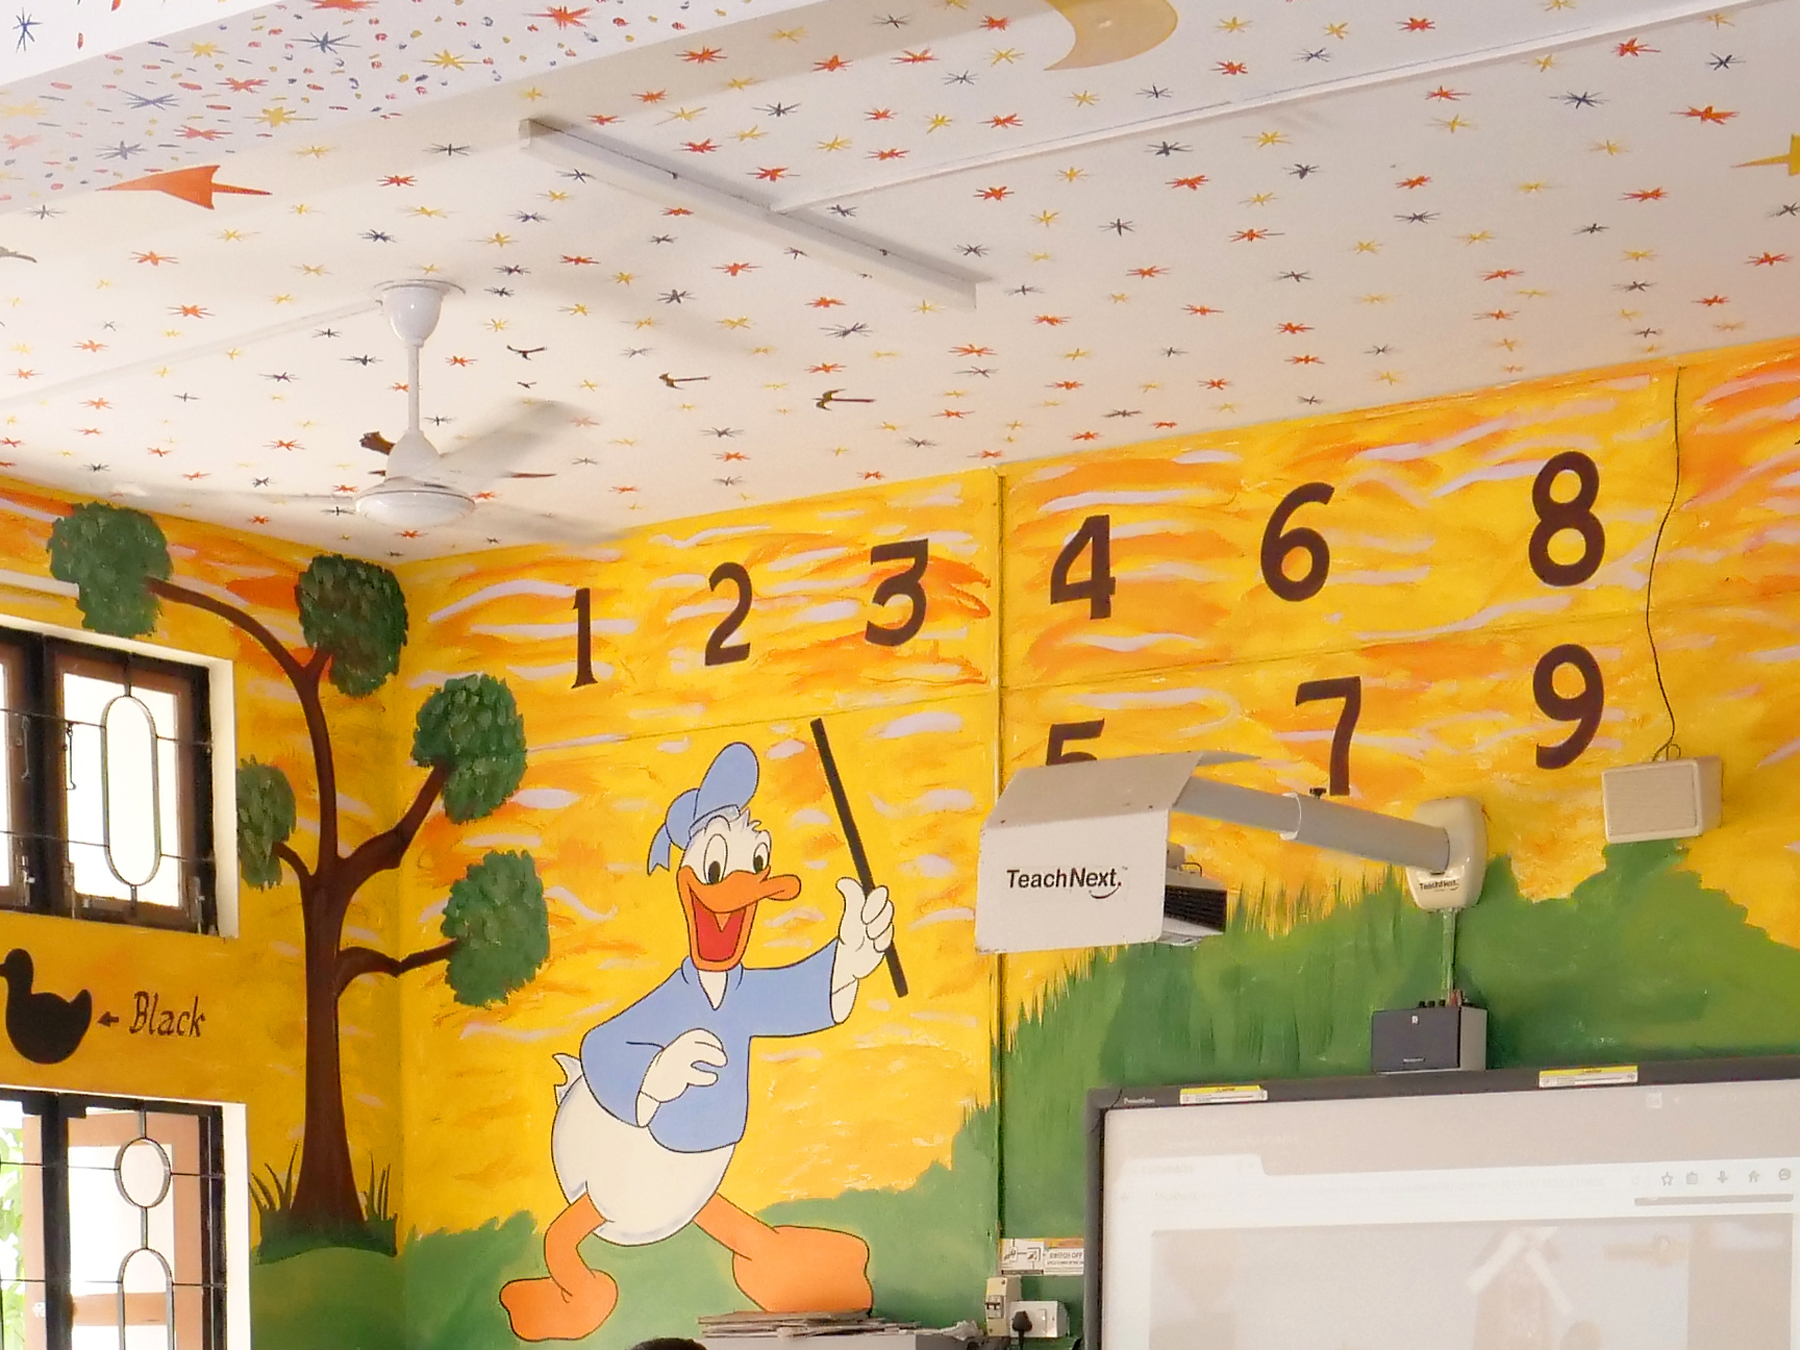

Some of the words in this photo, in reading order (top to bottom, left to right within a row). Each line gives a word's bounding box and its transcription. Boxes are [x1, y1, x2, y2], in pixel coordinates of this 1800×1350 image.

[1051, 514, 1116, 620] 4
[1261, 483, 1336, 601] 6
[1530, 451, 1604, 586] 8
[571, 588, 598, 689] 1
[704, 562, 751, 666] 2
[864, 538, 928, 647] 3
[1295, 675, 1362, 796] 7
[1533, 644, 1604, 769] 9
[129, 990, 206, 1038] Black
